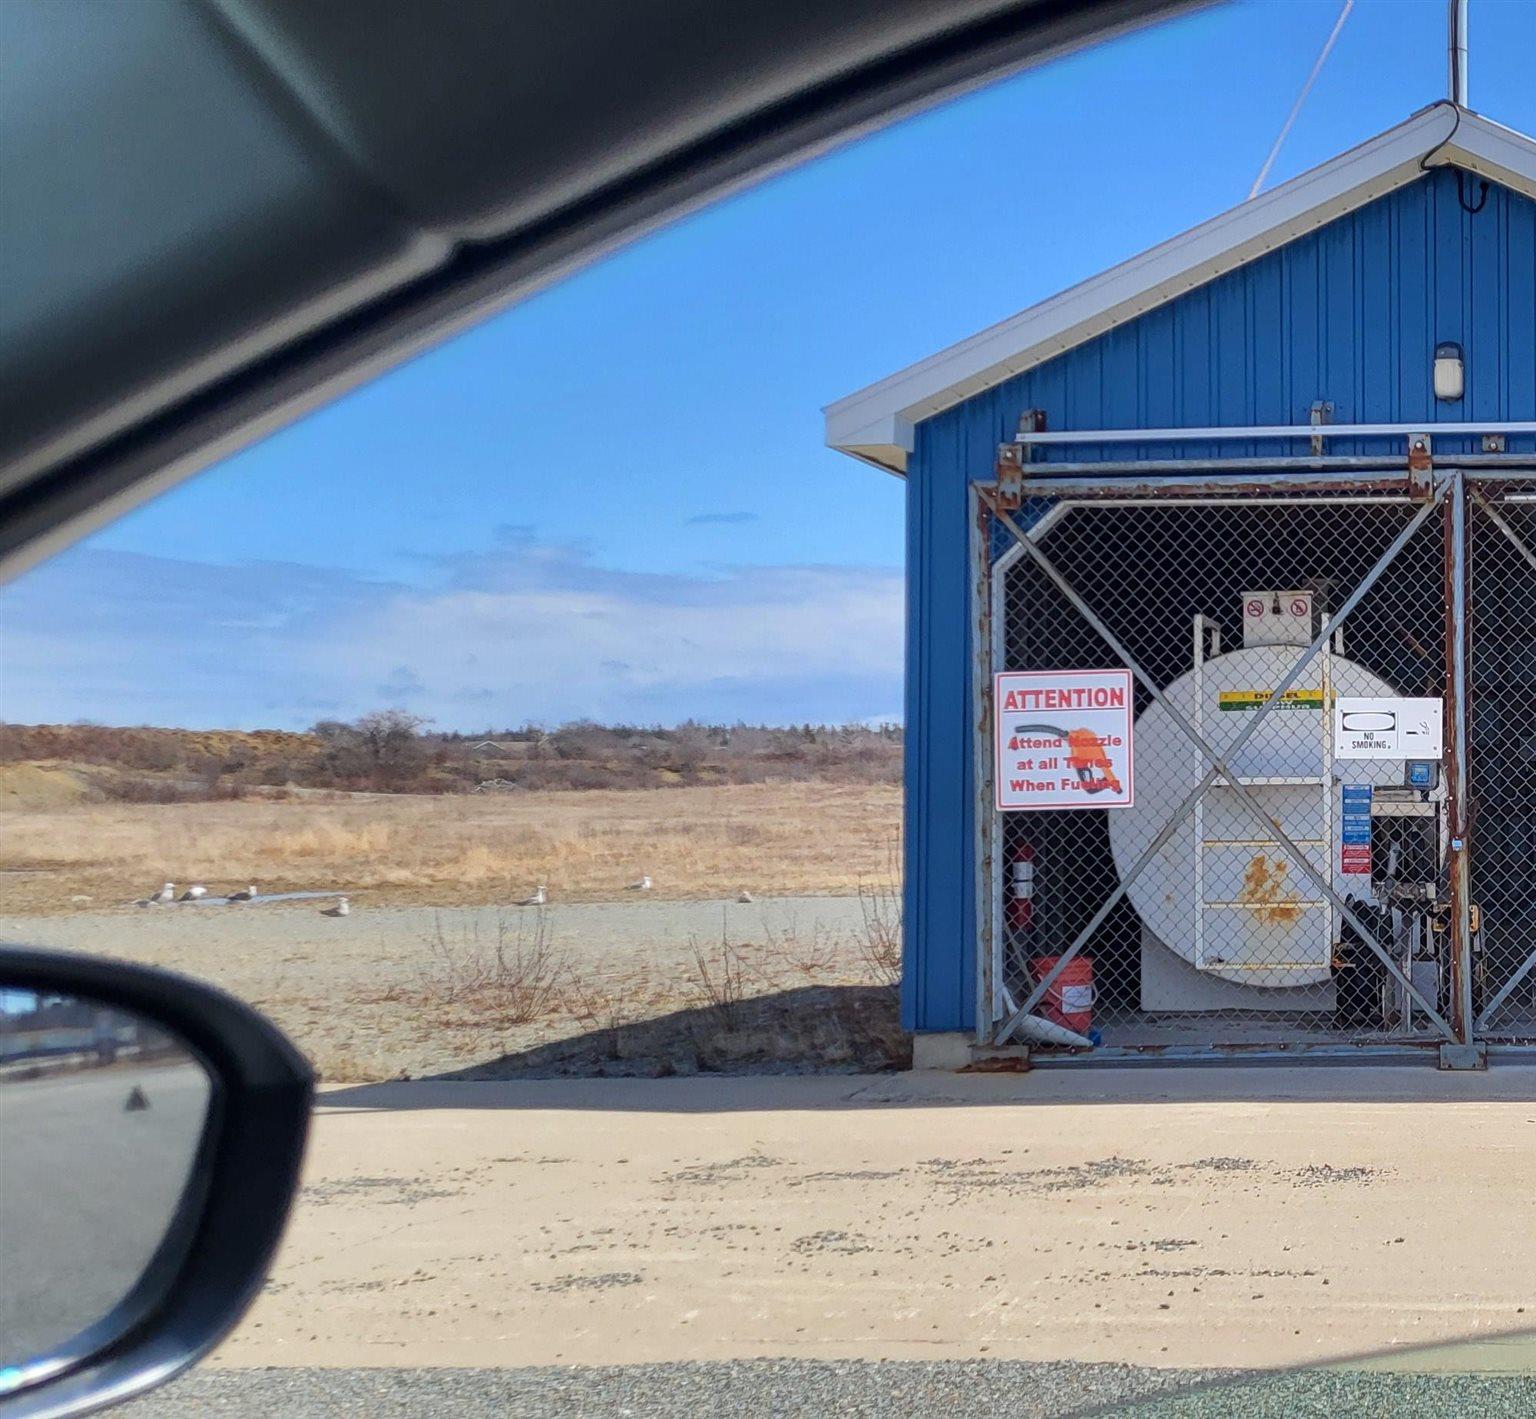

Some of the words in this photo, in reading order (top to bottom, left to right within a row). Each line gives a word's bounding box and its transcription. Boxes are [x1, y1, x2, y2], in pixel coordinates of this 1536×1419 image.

[1004, 687, 1124, 709] ATTENTION
[1008, 735, 1062, 750] Attend
[1068, 734, 1122, 748] Nozzle
[1363, 732, 1374, 741] NO
[1351, 740, 1387, 750] SMOKING
[1017, 759, 1034, 770] at
[1039, 757, 1058, 769] all
[1010, 778, 1055, 791] When
